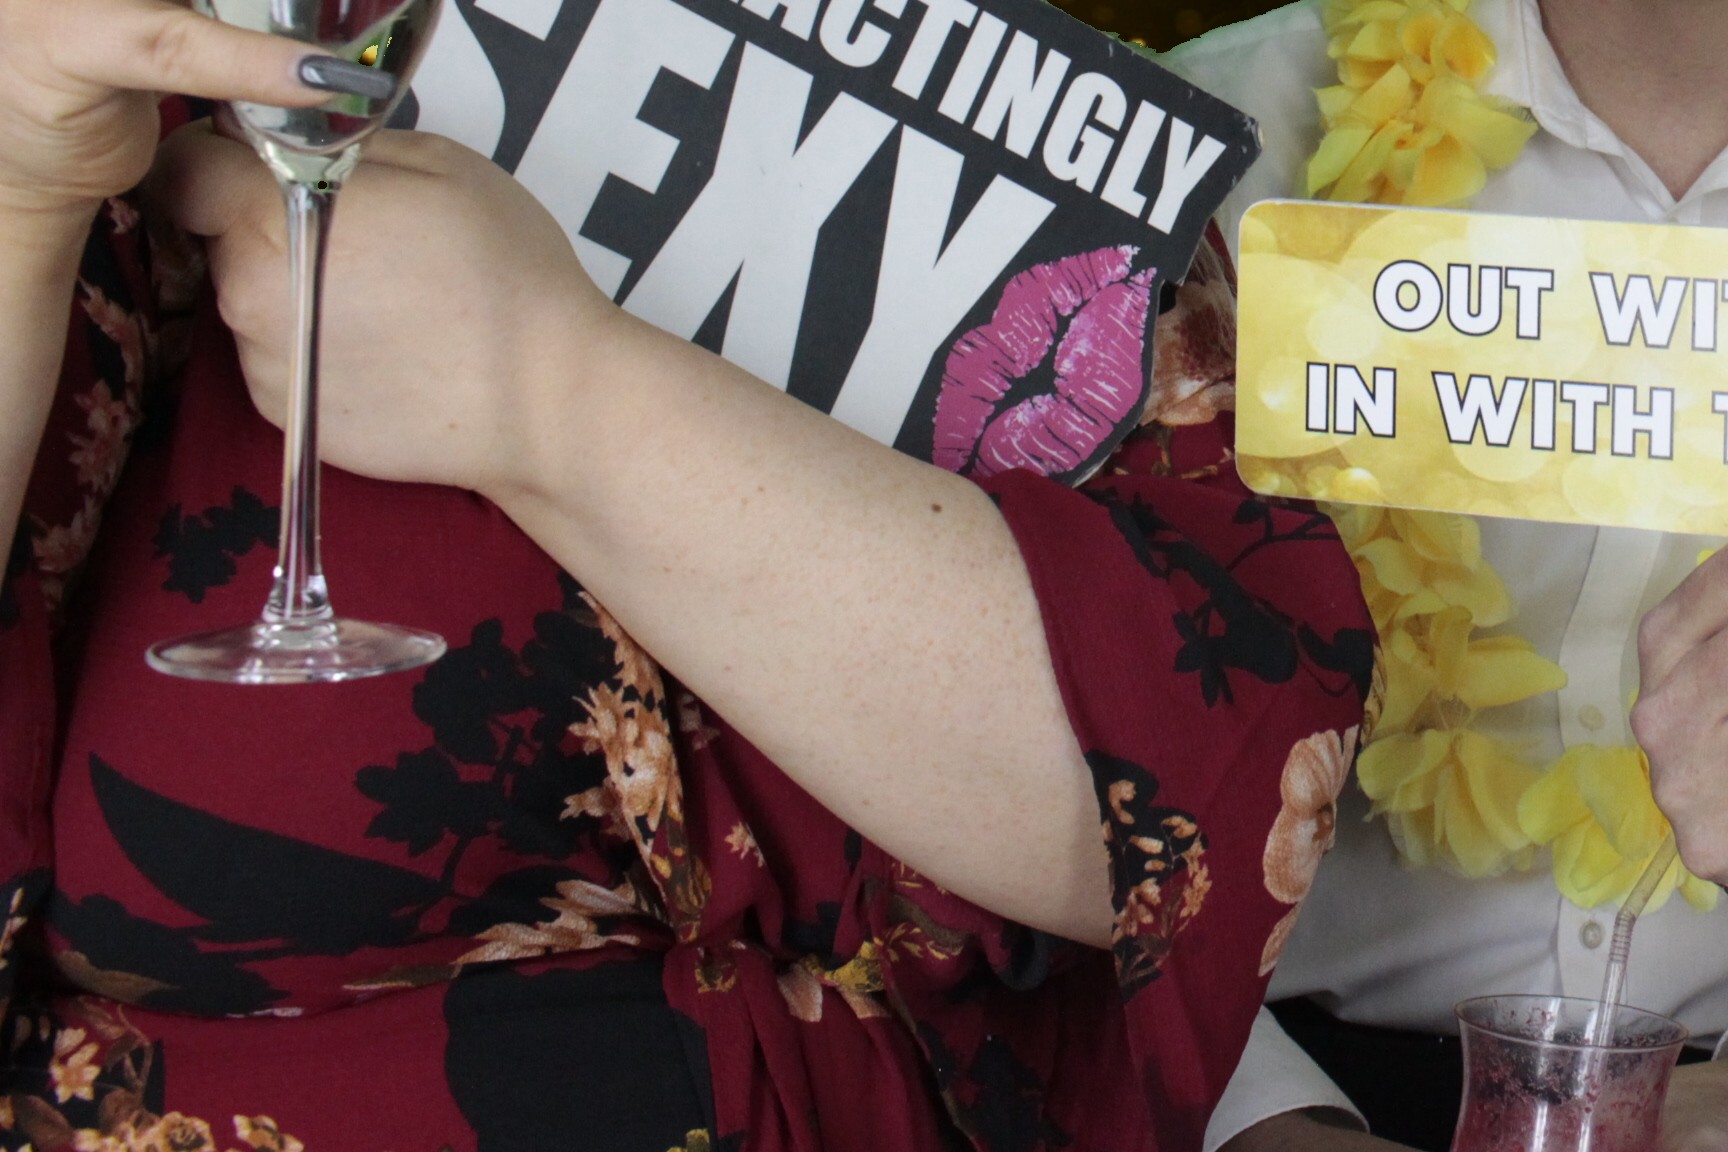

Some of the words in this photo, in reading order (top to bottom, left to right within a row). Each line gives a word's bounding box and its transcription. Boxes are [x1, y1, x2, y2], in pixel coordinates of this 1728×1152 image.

[1372, 258, 1555, 341] OUT
[1305, 362, 1397, 438] IN
[1431, 370, 1675, 461] WITH
